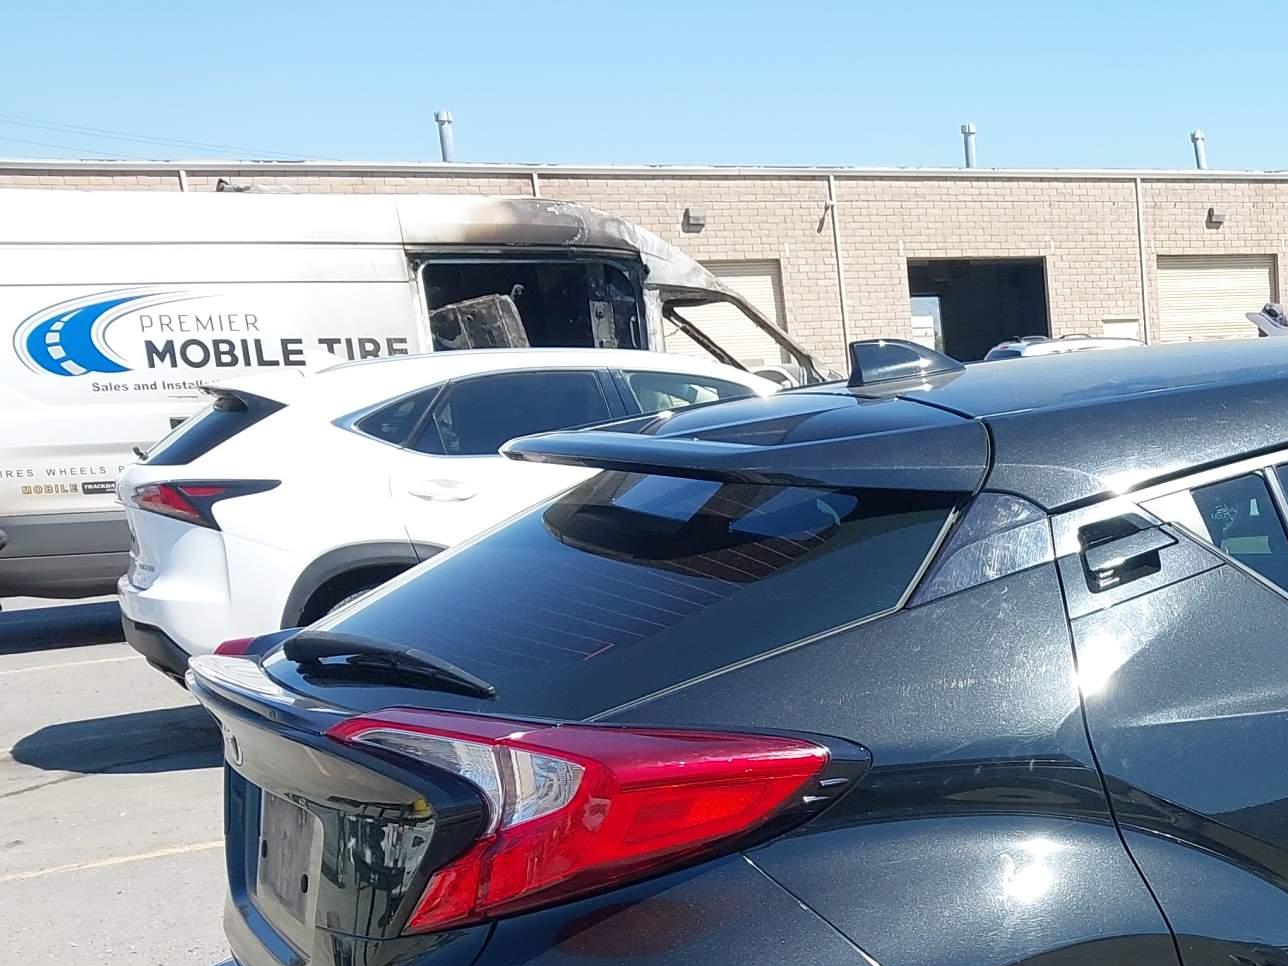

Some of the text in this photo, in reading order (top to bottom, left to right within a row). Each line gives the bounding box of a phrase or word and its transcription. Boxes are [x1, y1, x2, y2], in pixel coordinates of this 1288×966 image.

[139, 313, 260, 333] PREMIER
[144, 338, 306, 368] MOBILE
[92, 381, 129, 392] Sales
[133, 380, 158, 391] and
[46, 466, 106, 477] WHEELS
[21, 483, 78, 495] MOBILE
